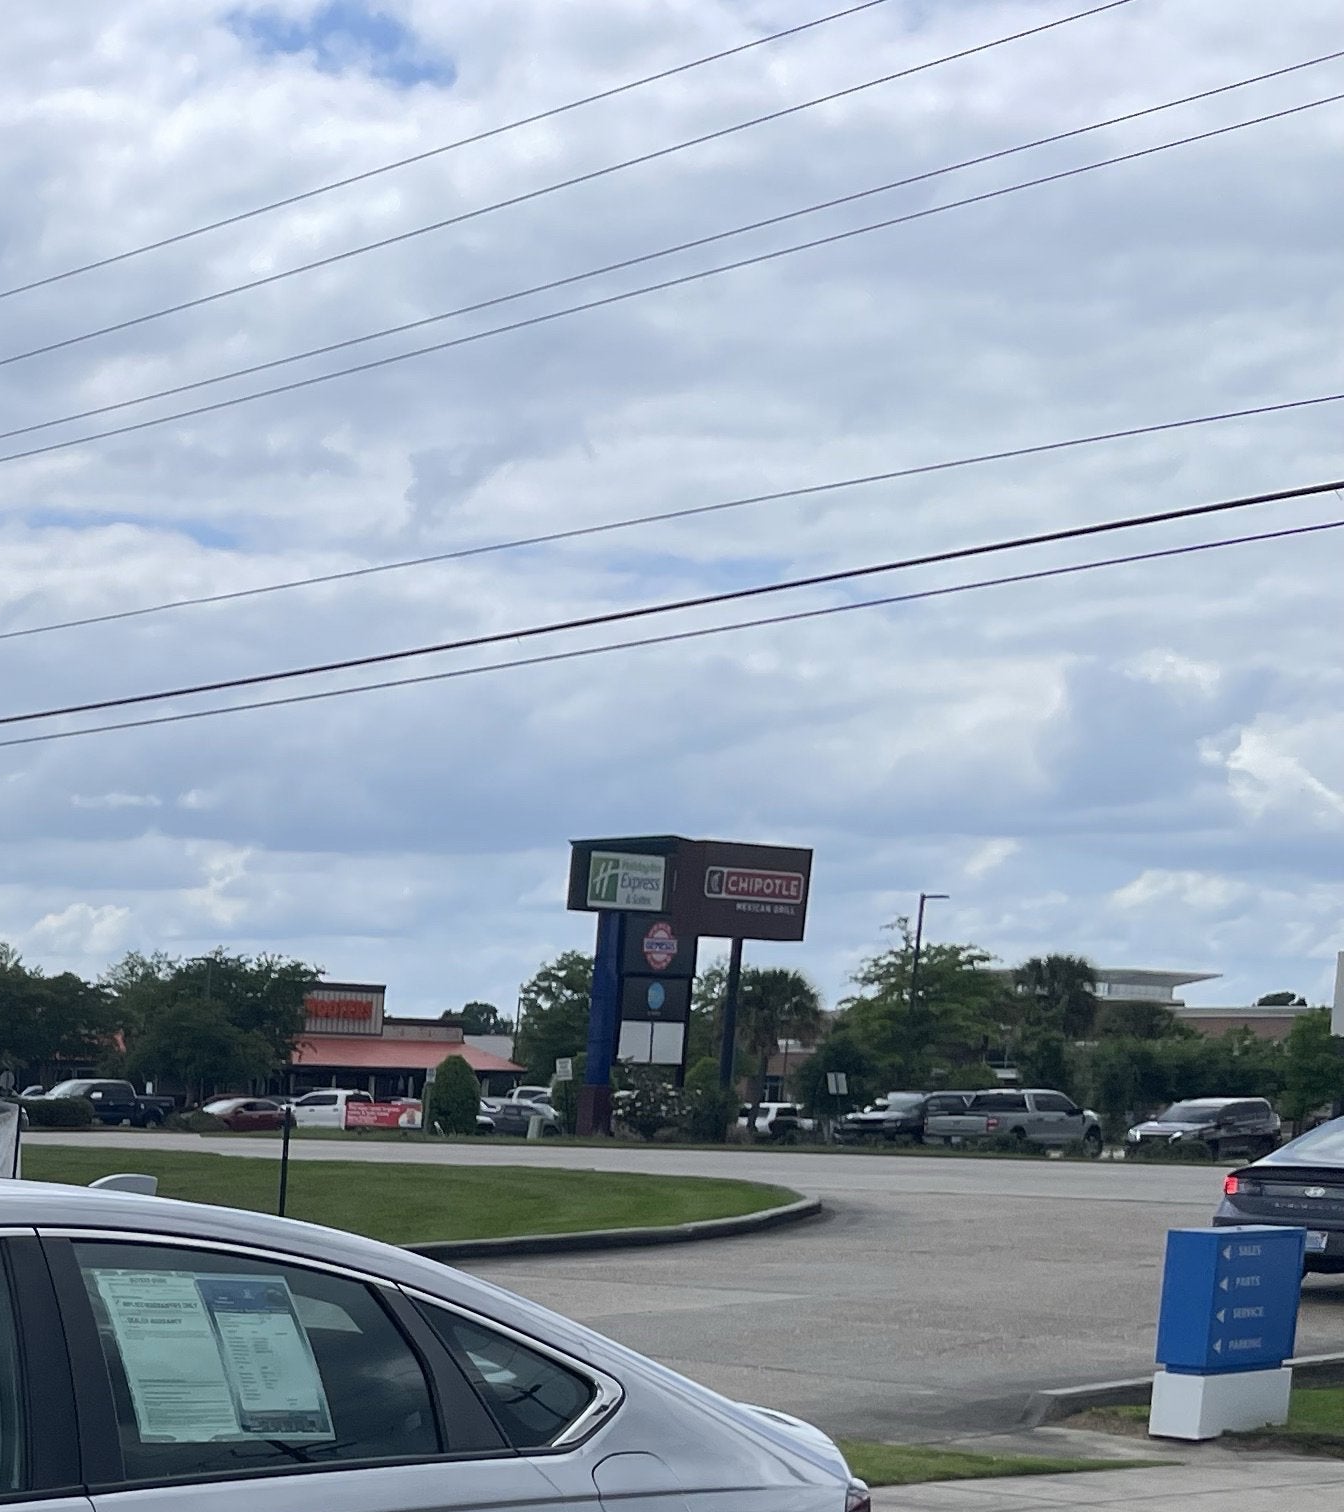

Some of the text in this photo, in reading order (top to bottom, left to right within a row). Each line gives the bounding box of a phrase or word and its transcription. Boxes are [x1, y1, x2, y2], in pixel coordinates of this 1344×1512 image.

[621, 872, 661, 892] Express
[728, 876, 799, 896] CHIPOTLE
[1236, 1275, 1261, 1288] PARTS
[1232, 1306, 1264, 1319] SERVICE
